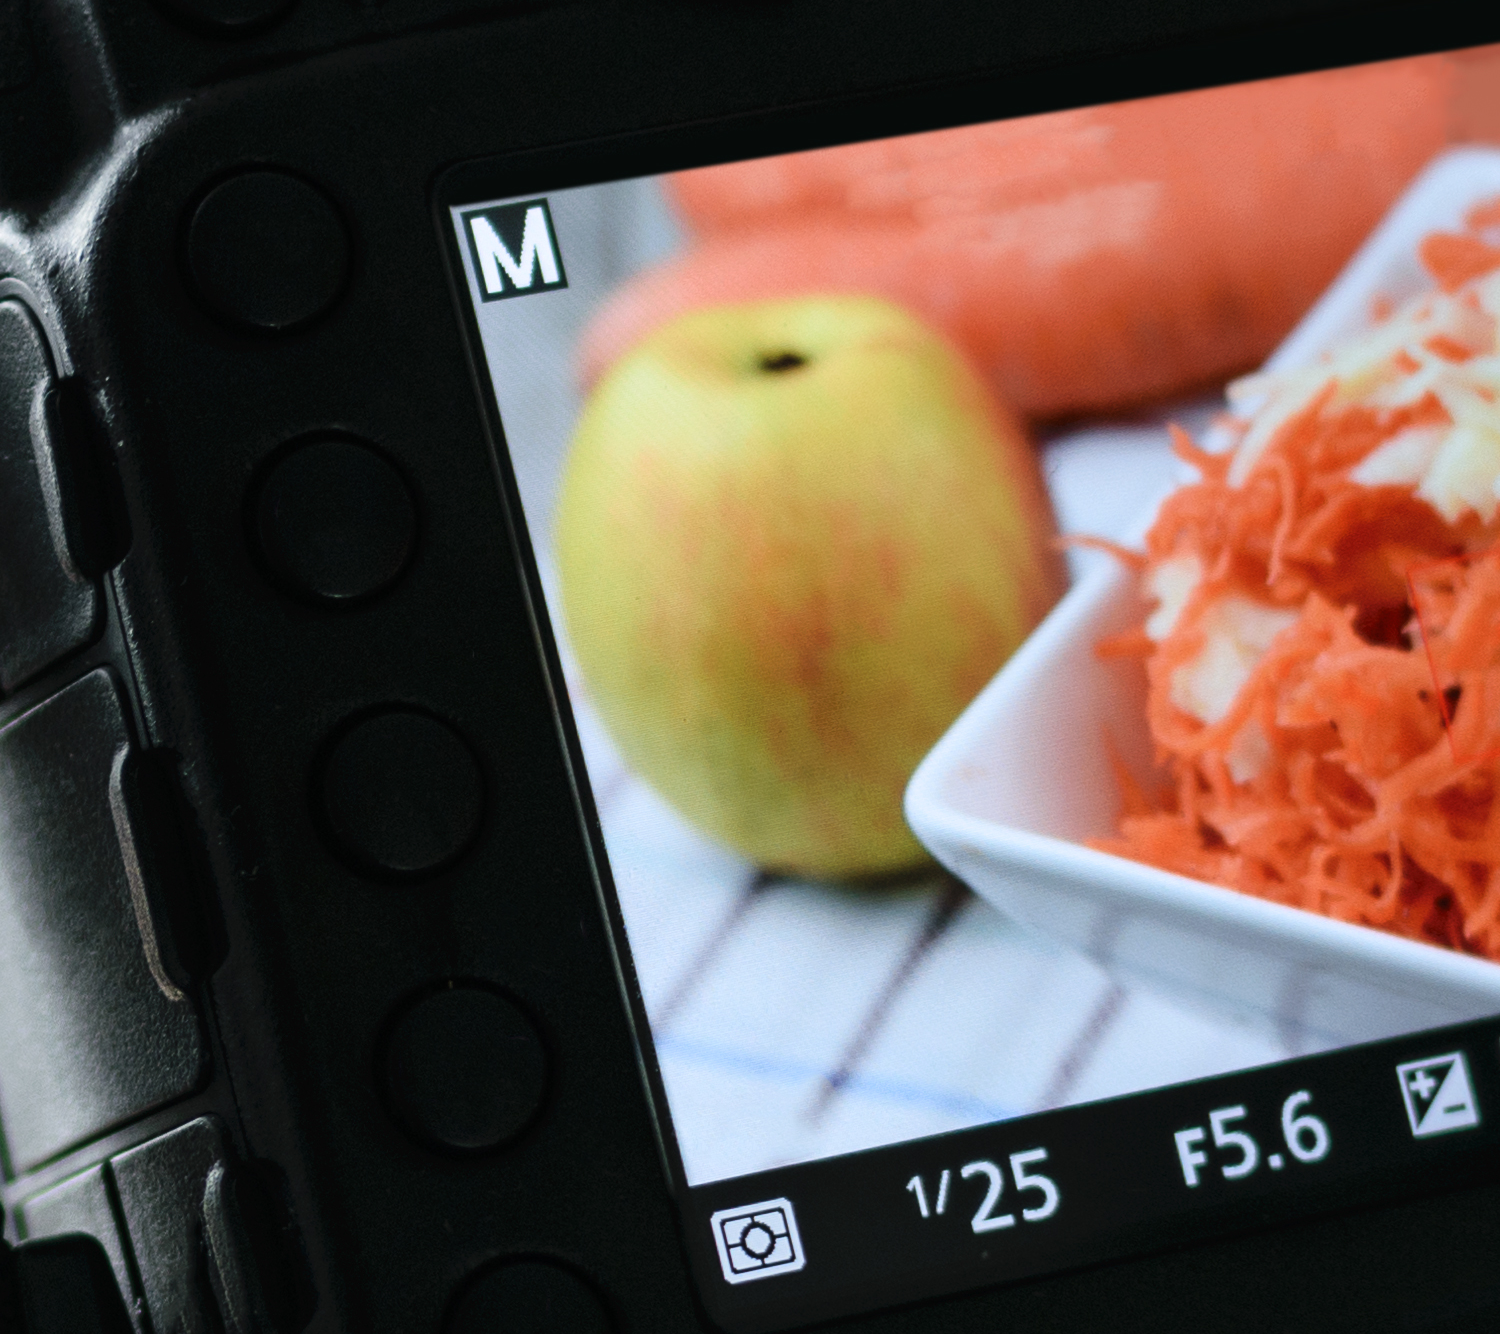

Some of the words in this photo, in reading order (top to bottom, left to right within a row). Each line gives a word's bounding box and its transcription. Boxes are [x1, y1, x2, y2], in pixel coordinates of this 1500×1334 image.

[469, 206, 560, 295] M
[906, 1147, 1061, 1234] 1/25
[1173, 1090, 1330, 1187] F5.6
